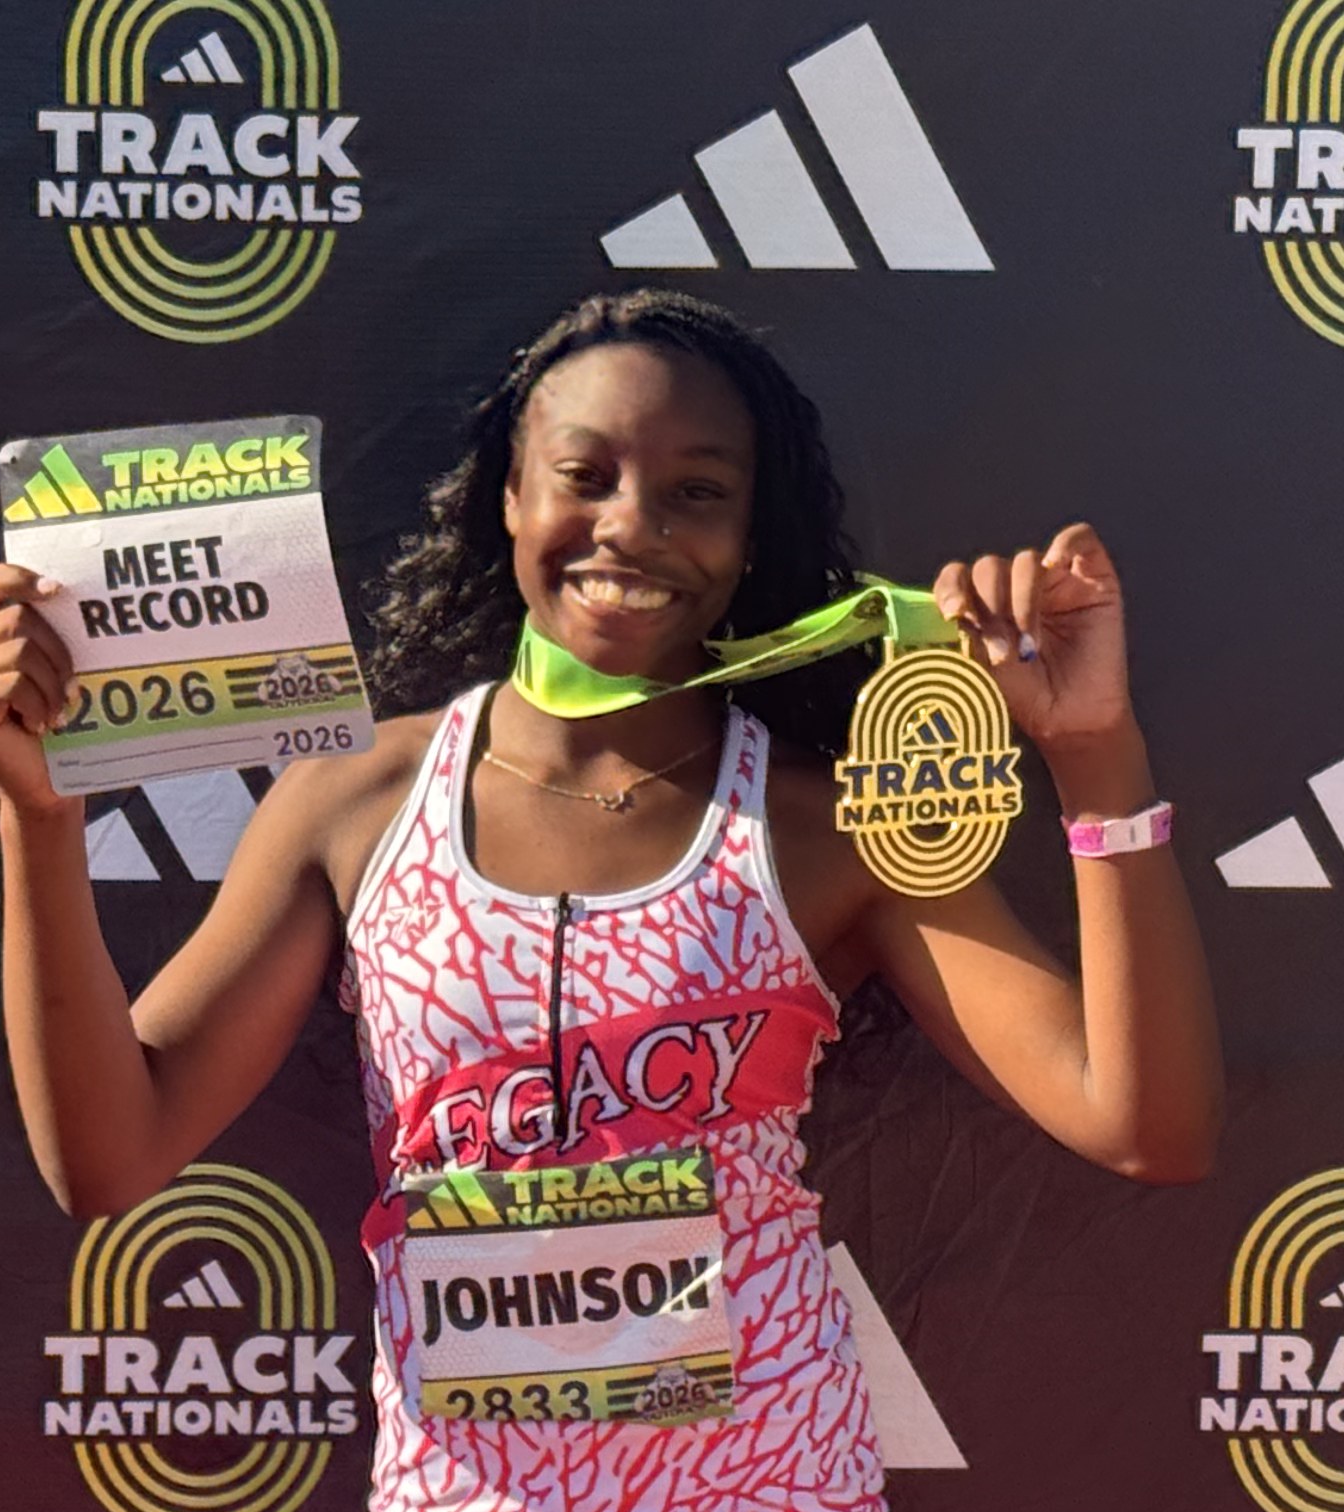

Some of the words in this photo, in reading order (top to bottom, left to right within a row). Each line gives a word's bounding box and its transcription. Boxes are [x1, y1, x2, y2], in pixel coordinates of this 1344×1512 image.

[39, 111, 360, 177] TRACK
[39, 181, 361, 222] NATIONALS
[102, 435, 310, 488] TRACK
[104, 466, 311, 512] NATIONALS
[102, 536, 223, 591] MEET
[79, 581, 270, 639] RECORD
[53, 671, 216, 736] 2026
[265, 672, 334, 700] 2026
[273, 723, 354, 757] 2026
[843, 755, 1018, 799] TRACK
[843, 791, 1018, 826] NATIONALS
[430, 1009, 771, 1172] EGACY
[504, 1158, 707, 1204] TRACK
[506, 1191, 711, 1226] NATIONALS
[422, 1256, 710, 1347] JOHNSON
[45, 1336, 353, 1393] TRACK
[46, 1401, 356, 1434] NATIONALS
[642, 1382, 706, 1411] 2026
